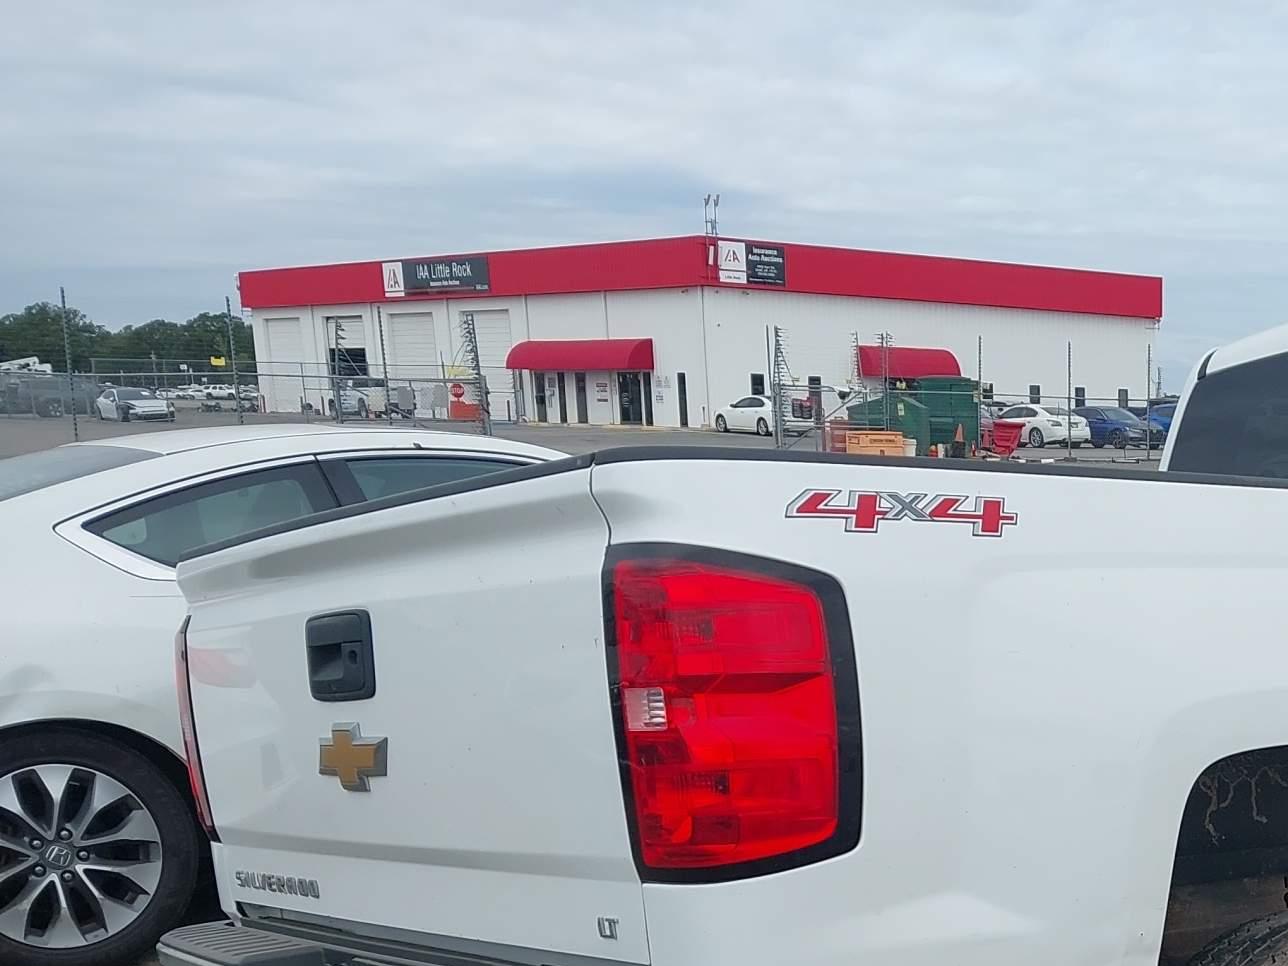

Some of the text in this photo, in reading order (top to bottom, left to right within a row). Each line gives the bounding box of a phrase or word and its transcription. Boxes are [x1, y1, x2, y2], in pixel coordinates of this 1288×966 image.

[416, 261, 473, 280] IAA Little Rock
[235, 871, 320, 899] SILVERADO
[597, 916, 620, 941] LT
